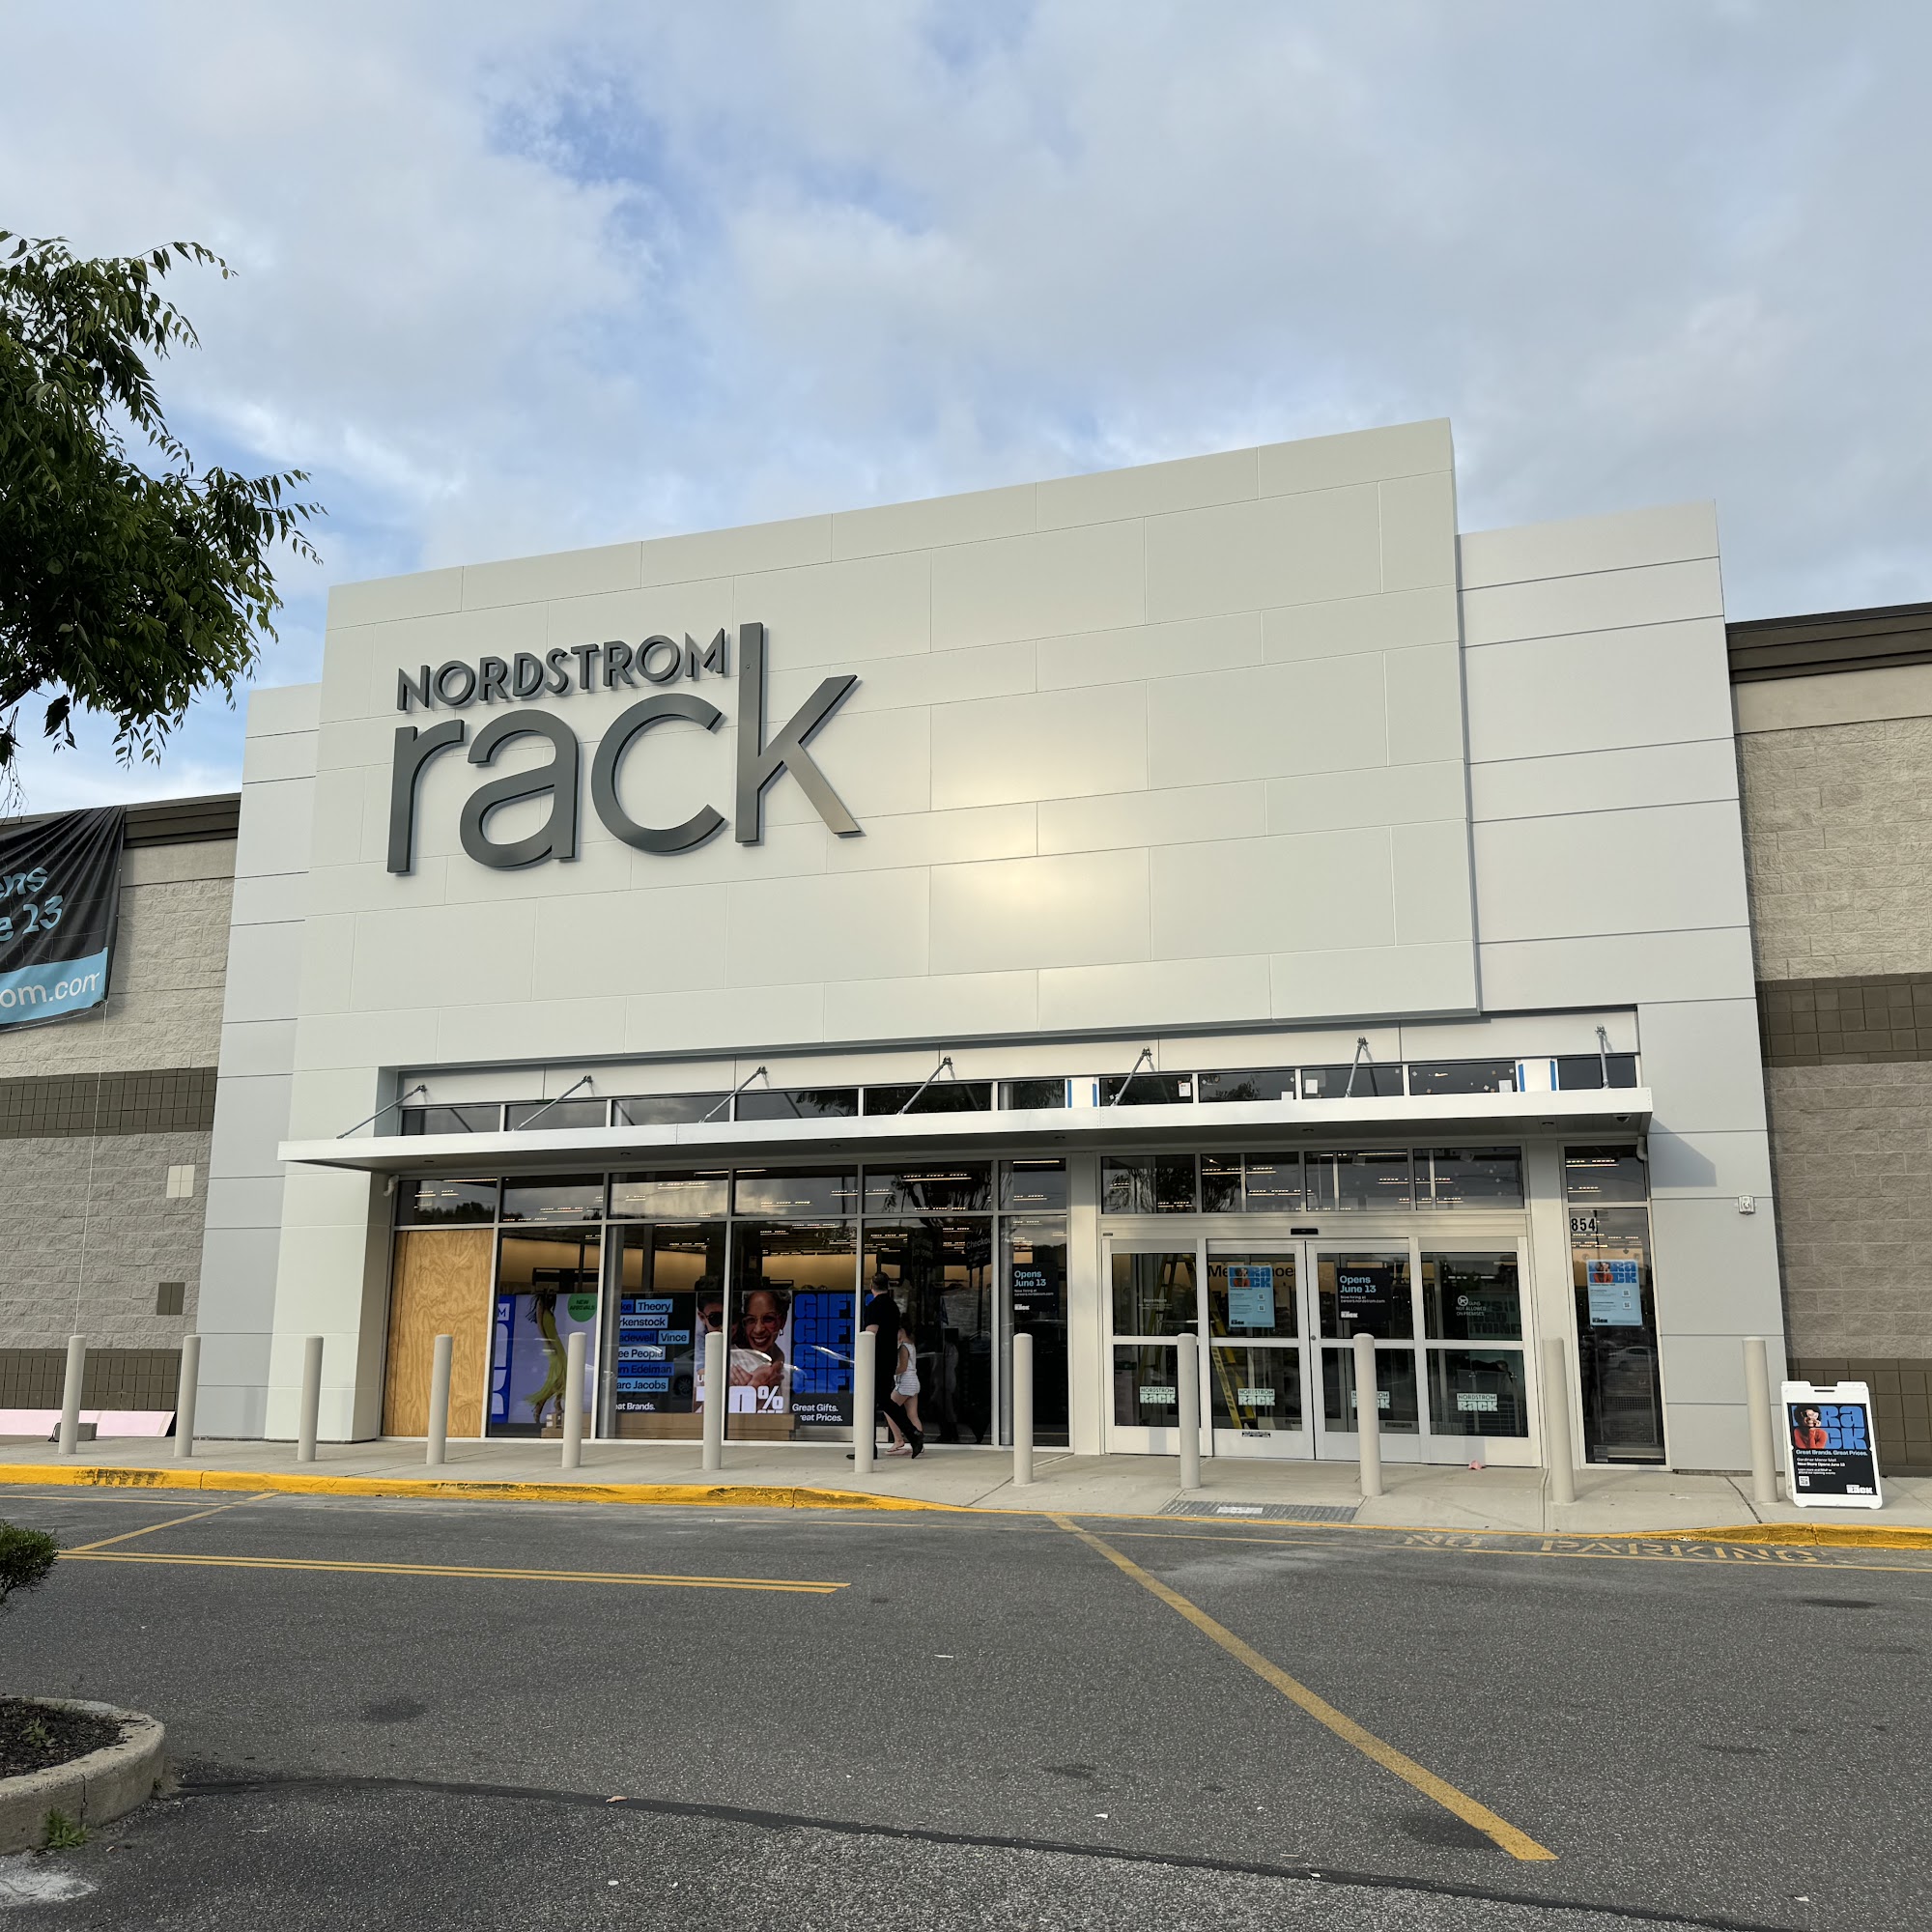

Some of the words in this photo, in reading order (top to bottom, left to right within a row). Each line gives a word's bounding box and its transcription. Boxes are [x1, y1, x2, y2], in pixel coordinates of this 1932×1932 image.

[396, 627, 730, 711] NORDSTROM
[386, 621, 864, 874] rack
[1571, 1218, 1596, 1232] 854
[1014, 1270, 1041, 1279] Opens
[1340, 1275, 1371, 1285] Opens
[1340, 1285, 1363, 1293] June
[1365, 1285, 1377, 1293] 13
[638, 1302, 670, 1312] Theory
[619, 1318, 666, 1326] rkenstock
[619, 1333, 654, 1342] adewell
[661, 1333, 687, 1342] Vince
[631, 1350, 663, 1359] People
[632, 1364, 672, 1373] Edelman
[633, 1380, 667, 1390] Jacobs
[1404, 1534, 1482, 1548] NO
[1540, 1540, 1818, 1563] PARKING
